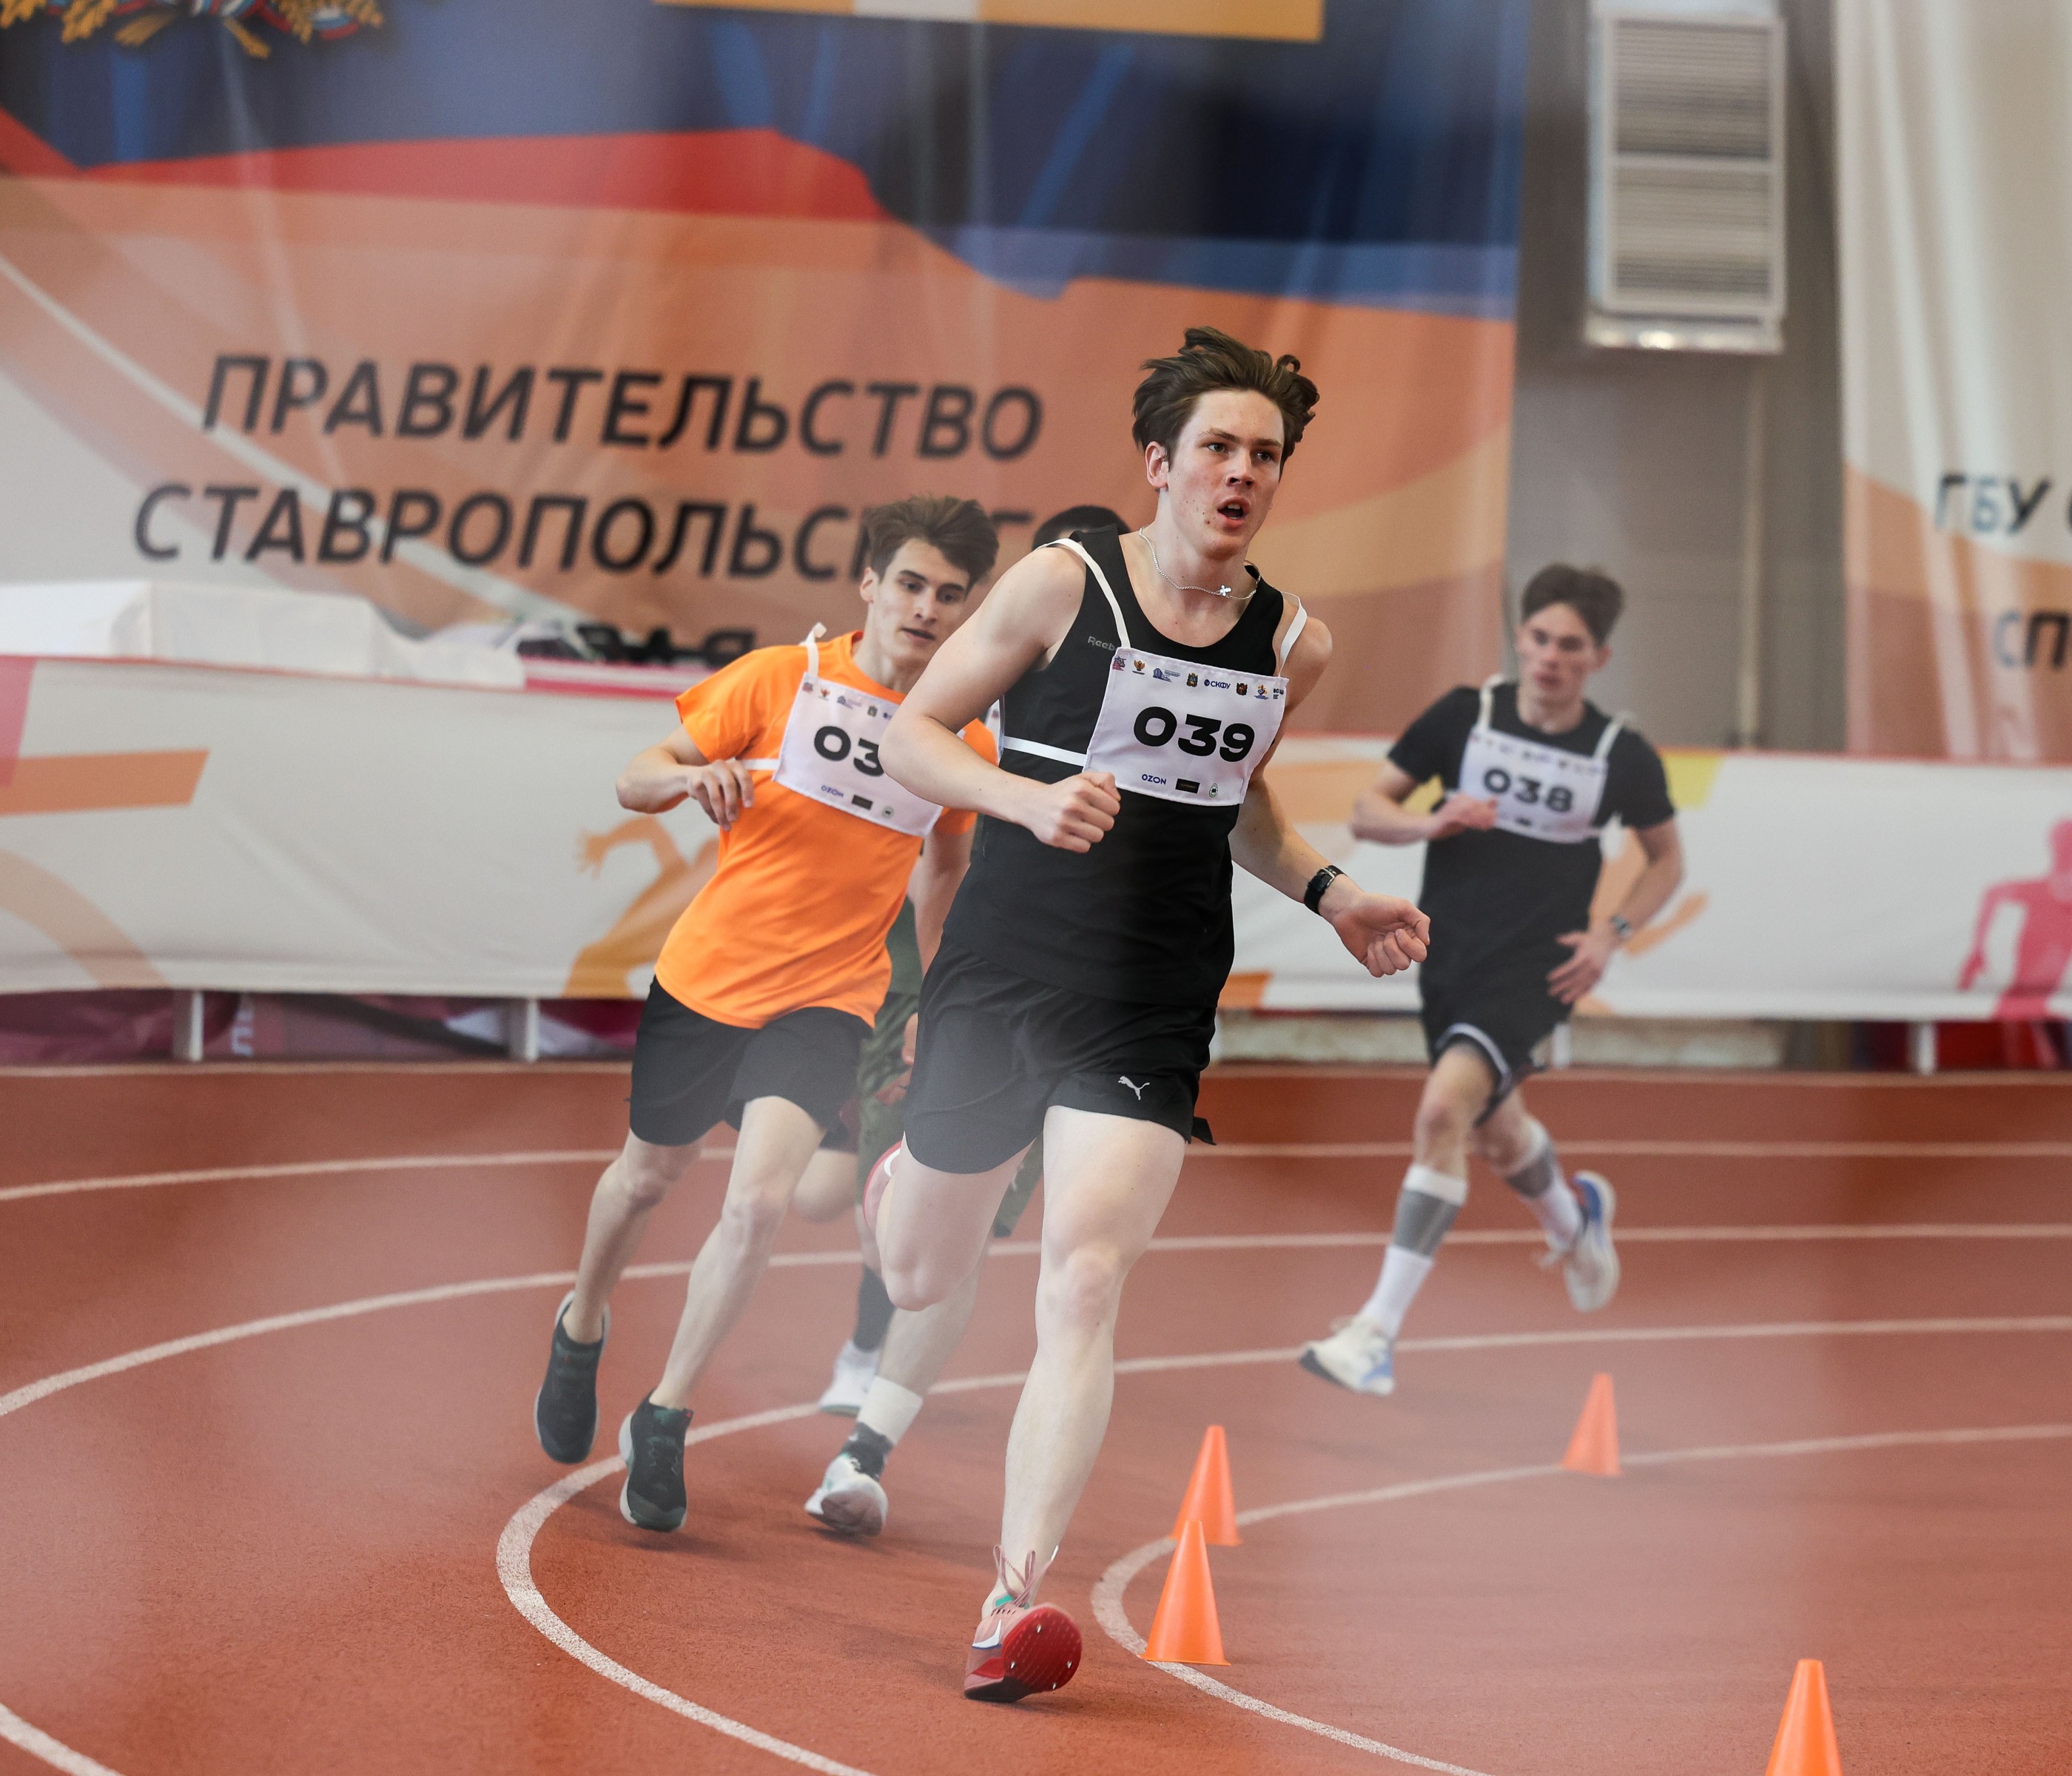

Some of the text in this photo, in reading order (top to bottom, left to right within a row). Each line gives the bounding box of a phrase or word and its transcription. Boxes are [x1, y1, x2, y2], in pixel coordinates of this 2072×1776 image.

[203, 352, 1045, 462] ПРАВИТЕЛЬСТВО
[1934, 471, 2054, 535] ГБУ
[133, 482, 1033, 580] СТАВРОПОЛЬС
[1087, 636, 1115, 651] Reeb
[813, 725, 885, 777] 03
[1133, 706, 1256, 763] 039
[1141, 773, 1167, 785] OZON
[1484, 767, 1573, 813] 038
